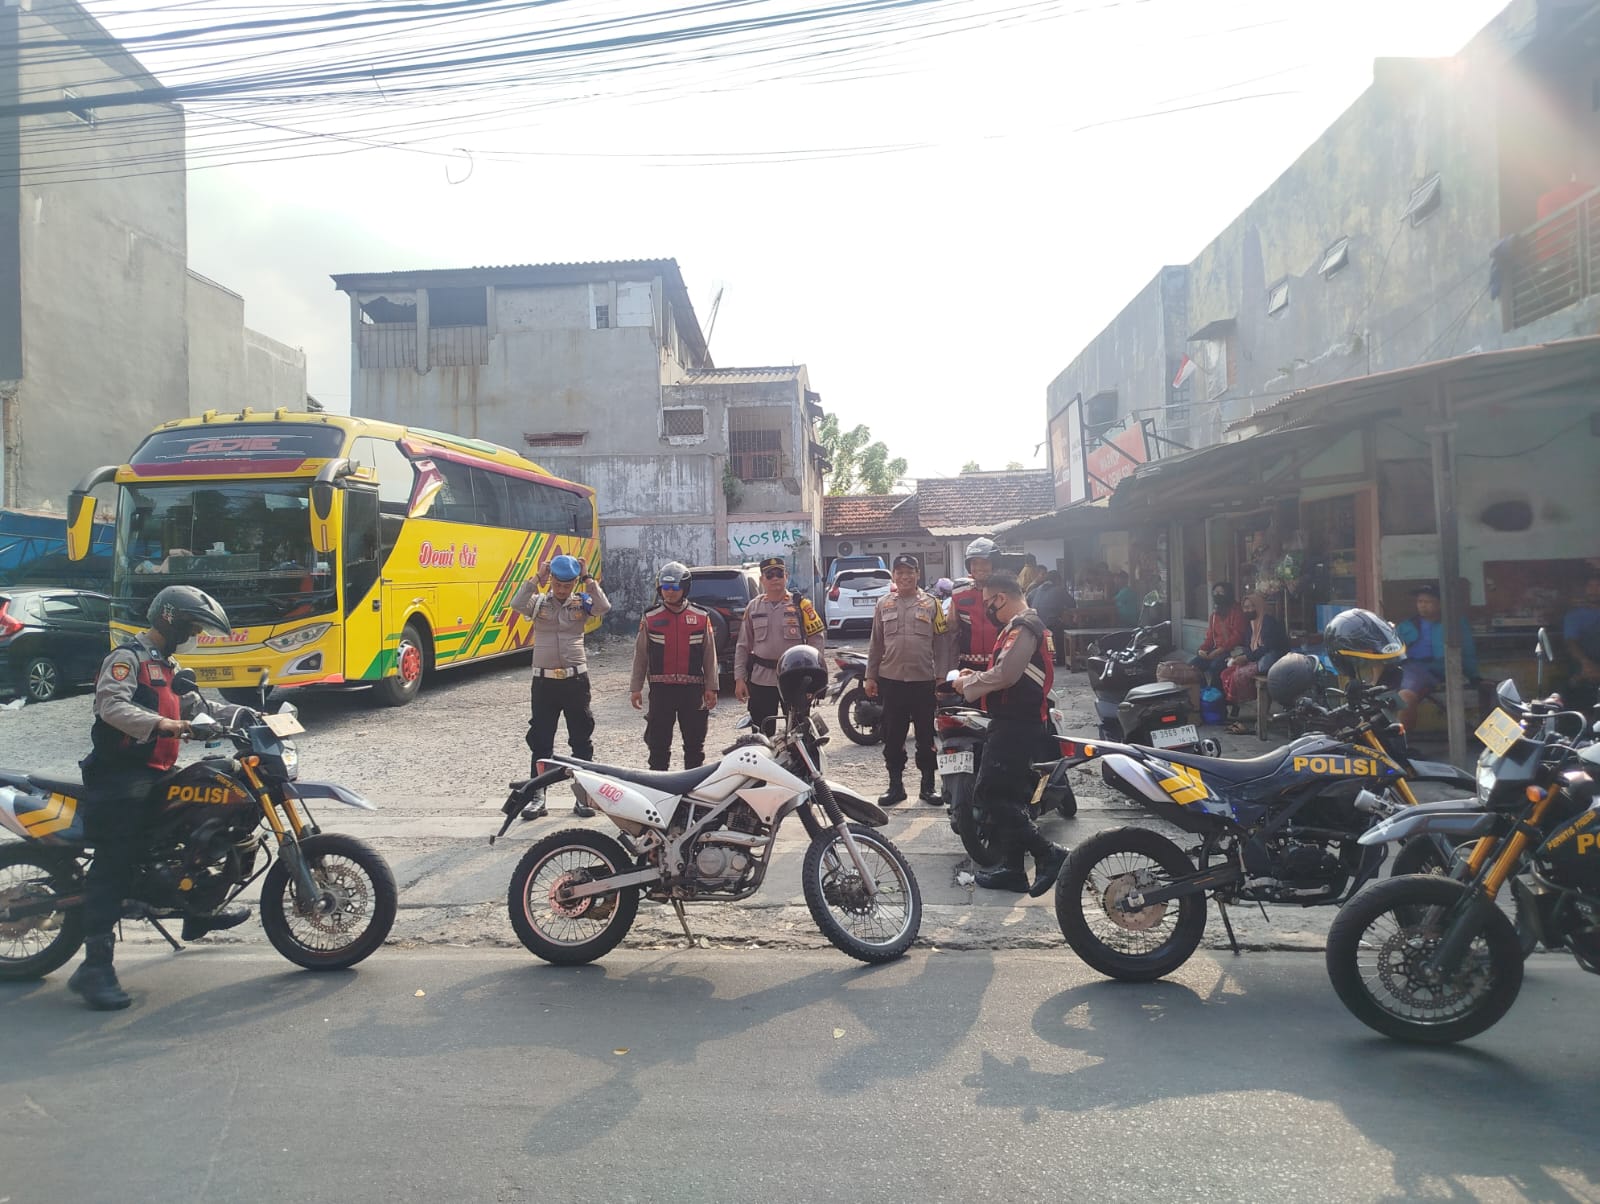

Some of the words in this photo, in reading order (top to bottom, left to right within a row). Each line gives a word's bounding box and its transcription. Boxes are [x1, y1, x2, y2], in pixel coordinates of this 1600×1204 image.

[419, 541, 455, 568] Dewi
[458, 543, 477, 568] Sri
[1293, 756, 1378, 777] POLISI
[167, 785, 230, 805] POLISI
[599, 783, 624, 802] 110
